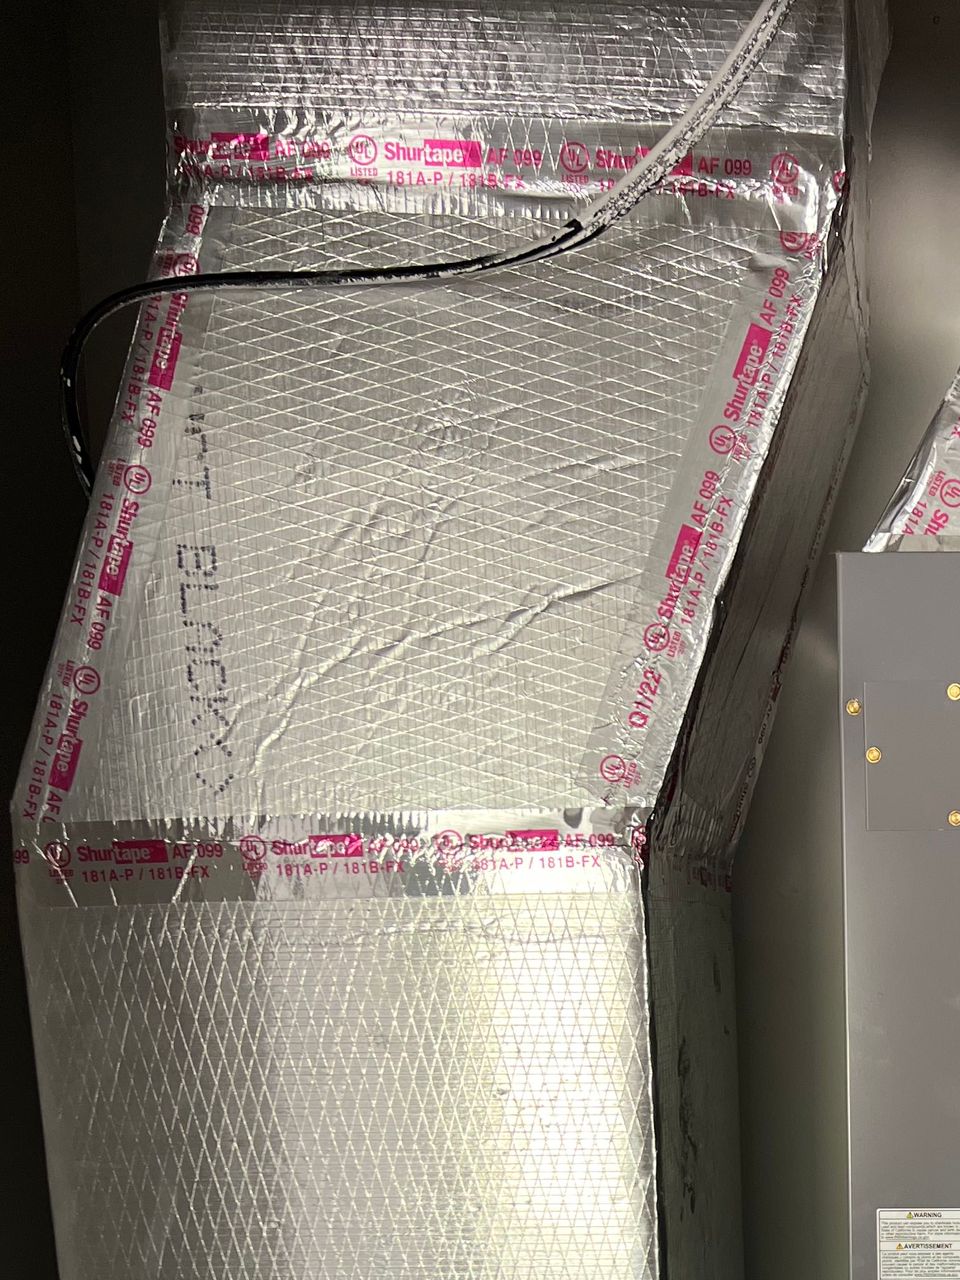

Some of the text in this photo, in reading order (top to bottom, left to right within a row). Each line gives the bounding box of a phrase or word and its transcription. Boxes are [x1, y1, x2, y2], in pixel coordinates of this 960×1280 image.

[384, 140, 463, 166] Shurtape
[698, 157, 751, 176] AF 099
[350, 167, 378, 178] LISTED
[387, 170, 443, 186] 181A-P
[724, 267, 790, 422] Shurtape AF 099
[121, 357, 146, 424] 181B-FX
[148, 390, 162, 417] AF
[137, 417, 157, 449] 099
[112, 457, 127, 487] LISTED
[699, 470, 721, 500] 099
[928, 470, 947, 498] LISTED
[93, 492, 115, 547] 181A-P
[690, 499, 709, 525] AF
[87, 498, 139, 651] Shurtape AF 099
[681, 495, 734, 626] 181A-P 181B-FX
[70, 562, 96, 626] 181B-FX
[61, 659, 76, 688] LISTED
[41, 693, 63, 748] 181A-P
[47, 698, 89, 816] Shurtape AF
[22, 763, 48, 821] 181B-FX
[77, 843, 224, 864] Shurtape AF 099
[277, 863, 328, 876] 181A-P
[342, 860, 405, 875] 181B-FX
[540, 854, 601, 870] 181B-FX
[82, 869, 134, 883] 181A-P
[149, 868, 210, 881] 181B-FX
